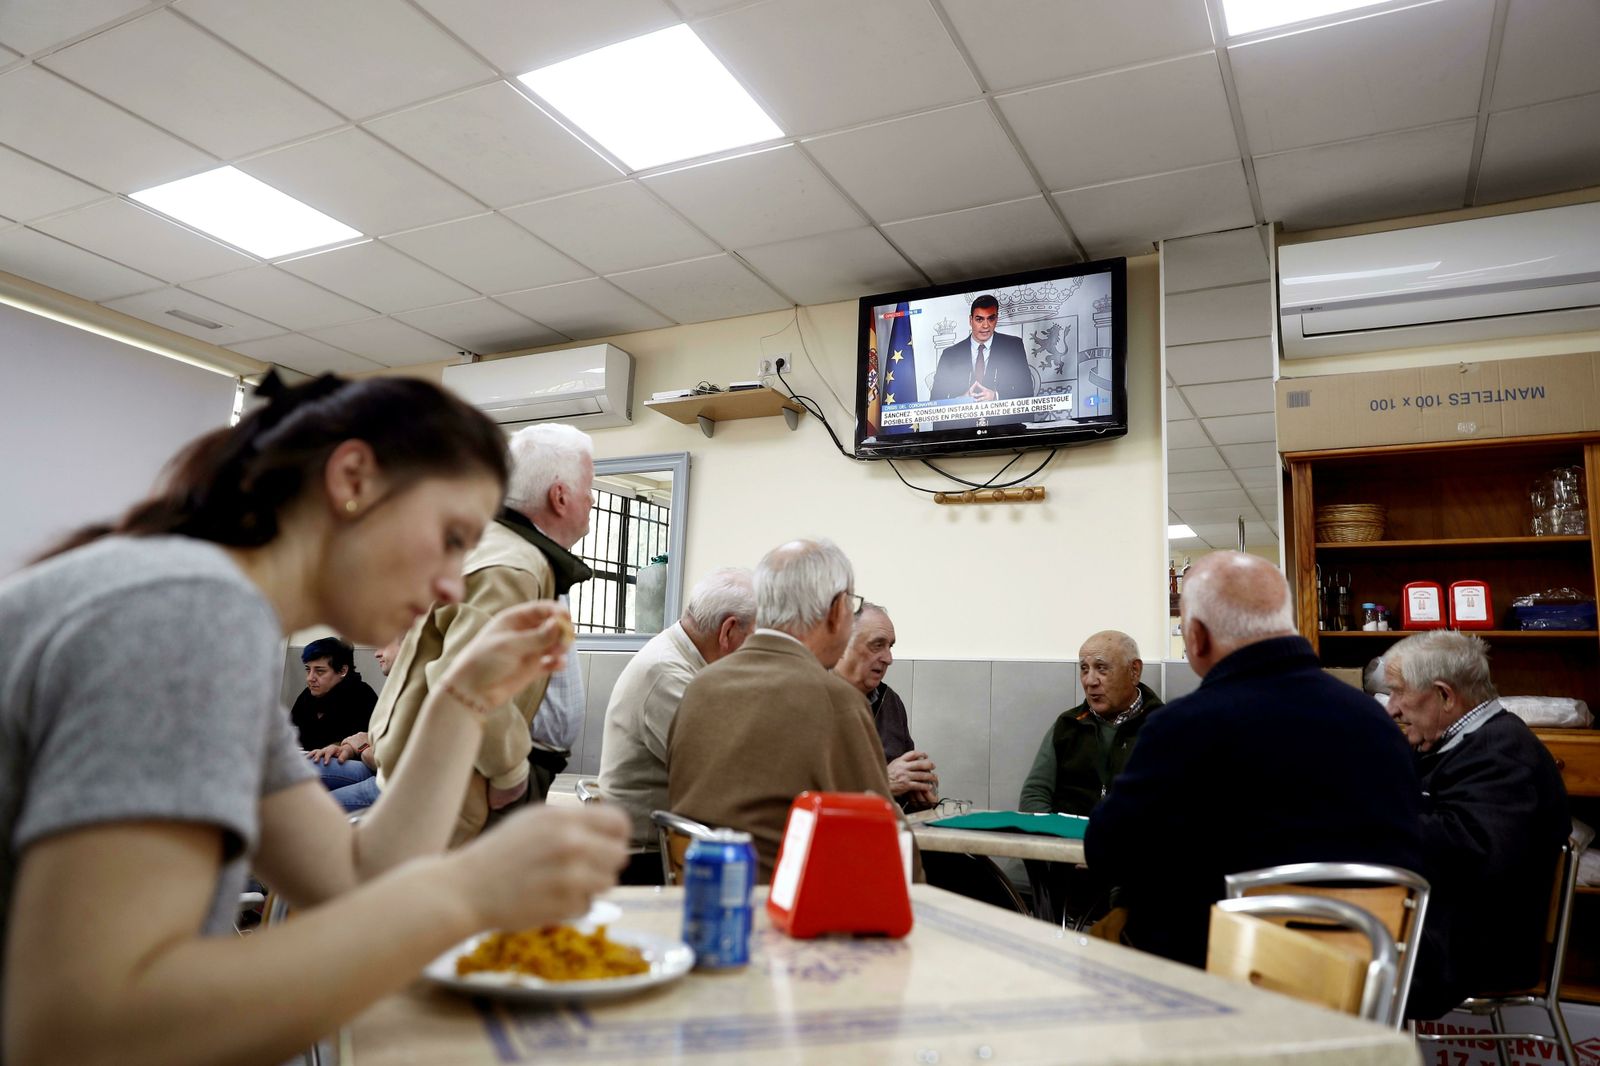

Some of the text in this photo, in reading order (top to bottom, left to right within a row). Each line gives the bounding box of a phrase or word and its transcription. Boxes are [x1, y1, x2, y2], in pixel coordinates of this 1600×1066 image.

[990, 400, 1009, 409] CNMC
[1016, 398, 1030, 406] QUE
[1031, 395, 1070, 405] INVESTIGUE
[1370, 386, 1545, 411] MANTELES 100 x 100
[883, 417, 913, 426] POSIBLES
[914, 415, 940, 423] ABUSOS
[950, 411, 978, 420] PRECIOS
[1002, 407, 1011, 415] DE
[1012, 405, 1030, 414] ESTA
